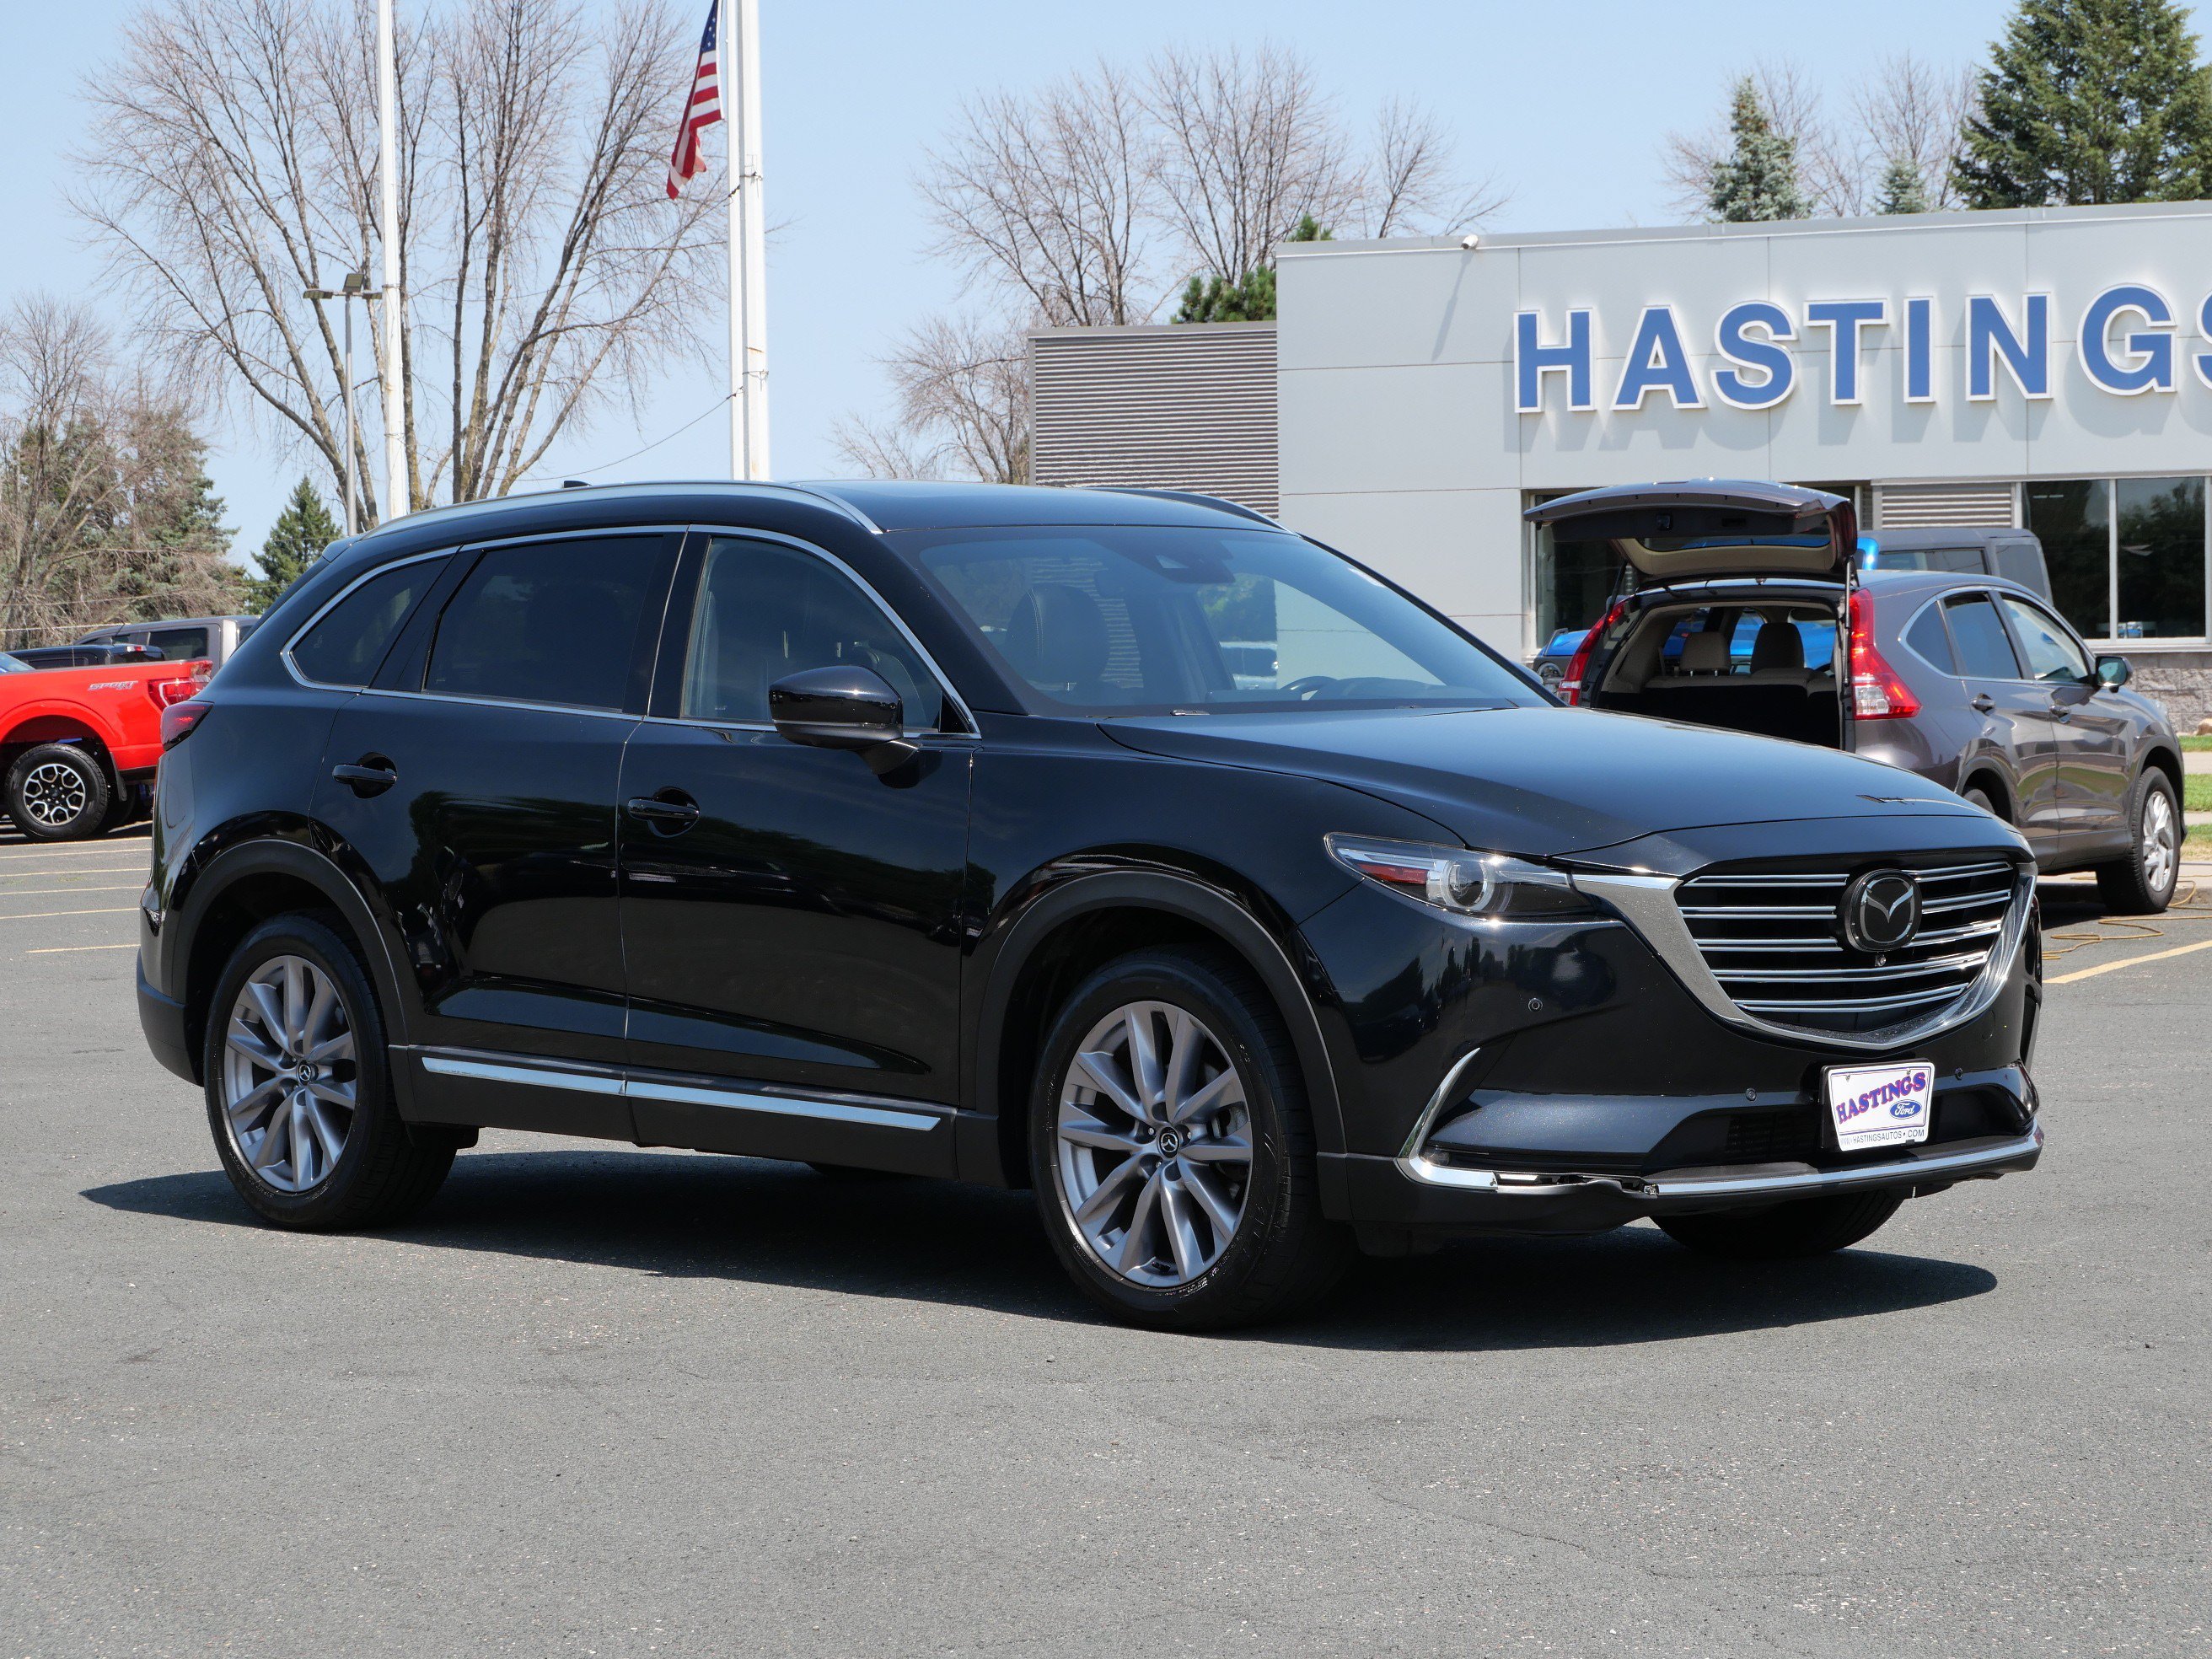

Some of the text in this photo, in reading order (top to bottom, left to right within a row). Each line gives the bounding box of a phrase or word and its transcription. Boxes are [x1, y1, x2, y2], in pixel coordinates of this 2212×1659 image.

[1514, 282, 2212, 413] HASTING
[1835, 1071, 1926, 1125] HASTINGS
[1895, 1103, 1914, 1115] Ford
